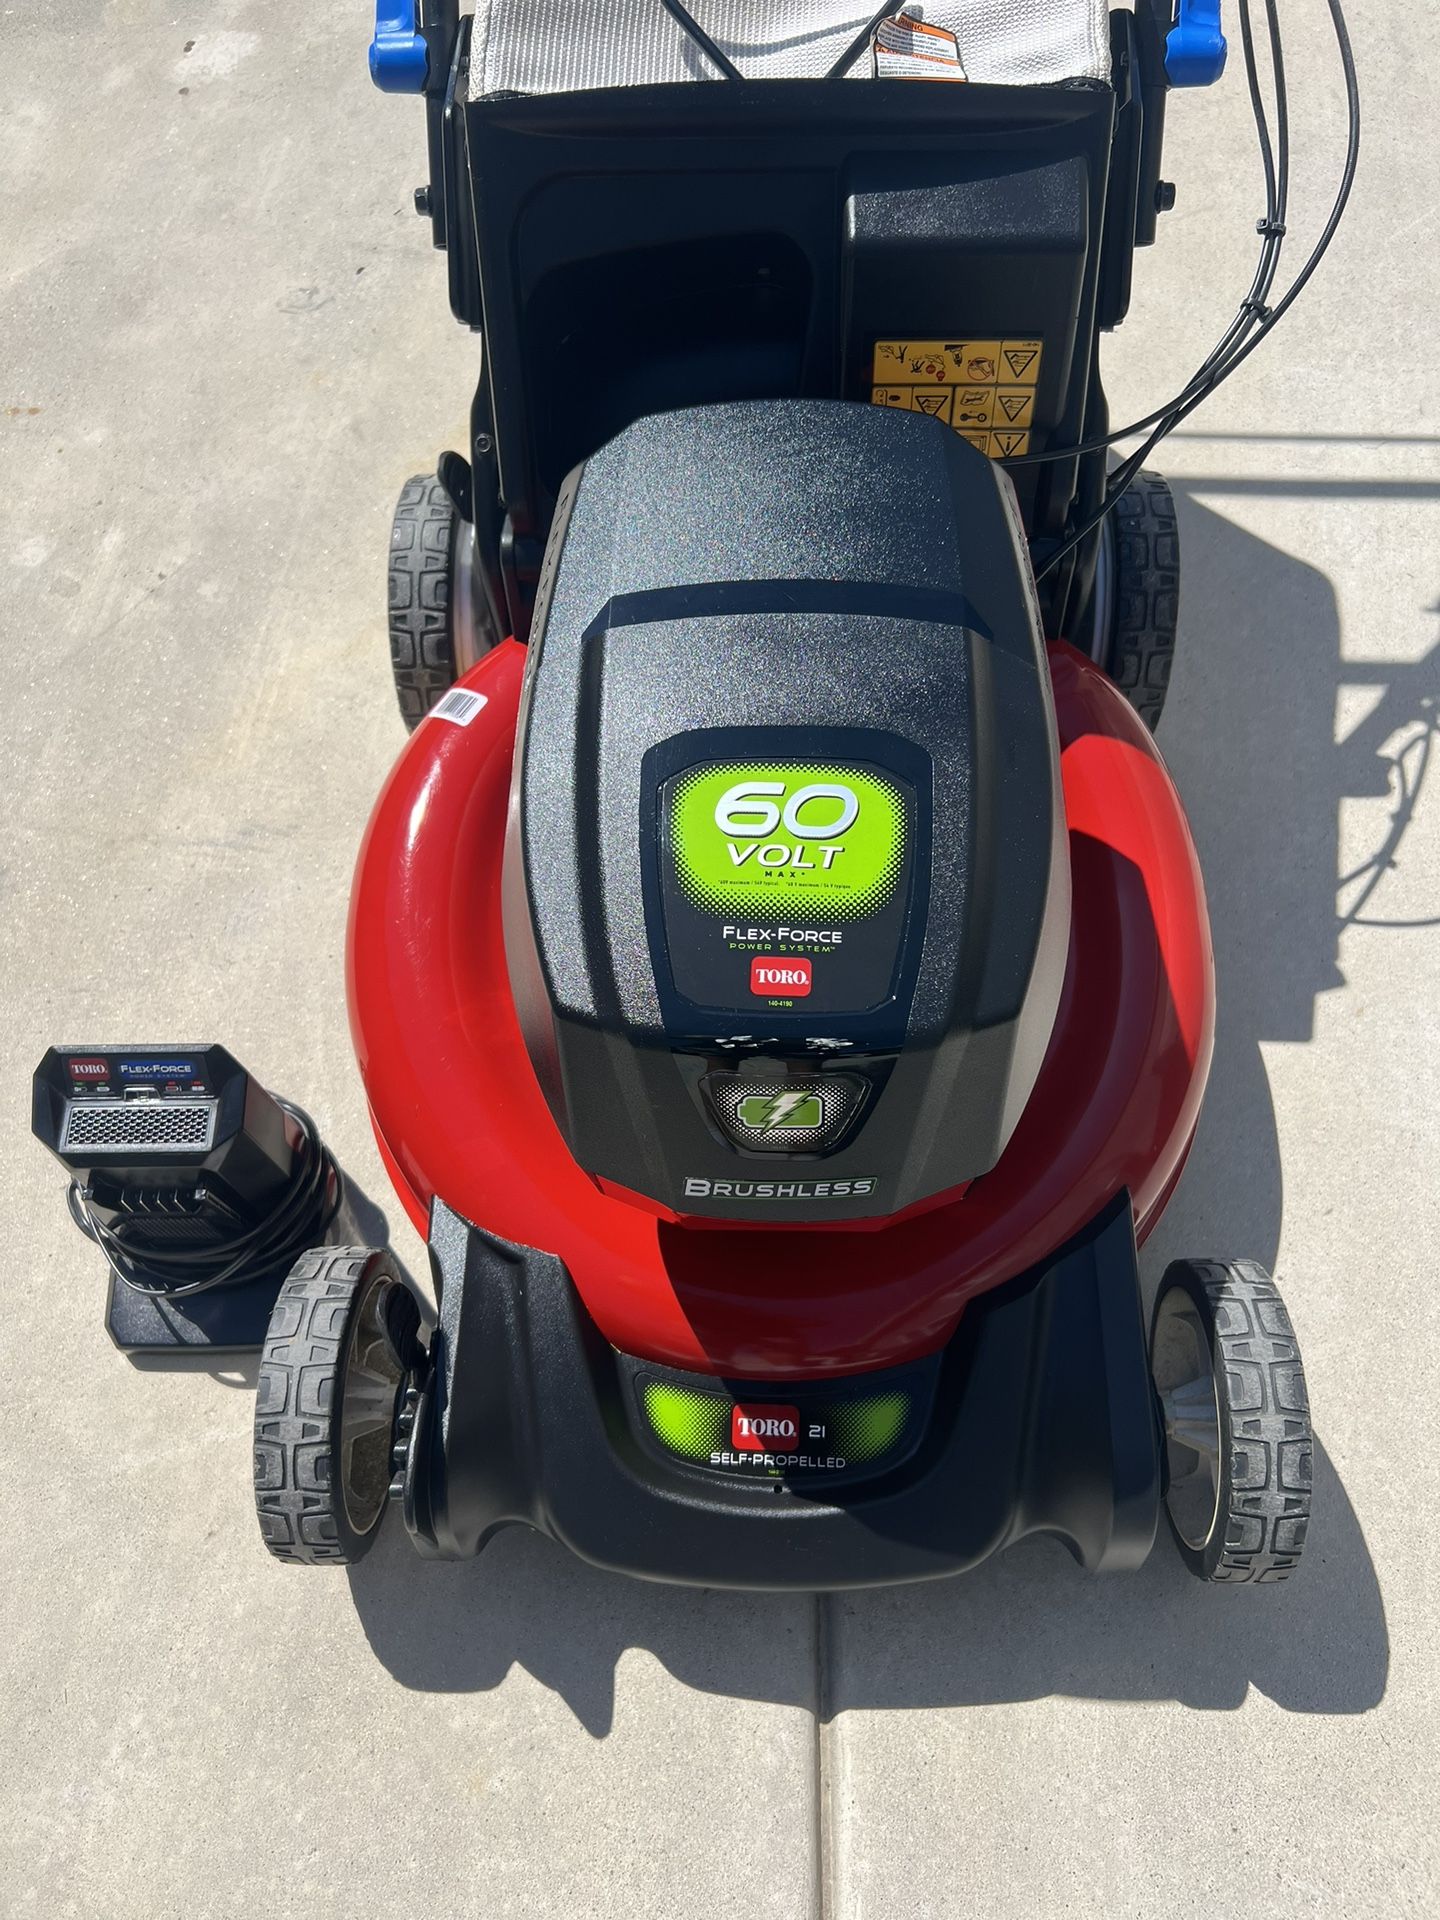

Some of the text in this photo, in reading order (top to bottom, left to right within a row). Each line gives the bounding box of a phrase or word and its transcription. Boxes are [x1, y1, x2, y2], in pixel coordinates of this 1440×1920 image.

[714, 781, 860, 840] 60
[727, 843, 844, 869] VOLT
[723, 926, 842, 943] FLEX-FORCE
[756, 969, 808, 985] TORO
[72, 1064, 107, 1074] TORO
[120, 1064, 191, 1073] FLEX-FORCE
[685, 1179, 872, 1197] BRUSHLESS
[738, 1416, 826, 1438] TORO 21
[710, 1452, 846, 1468] SELF-PROPELLED
